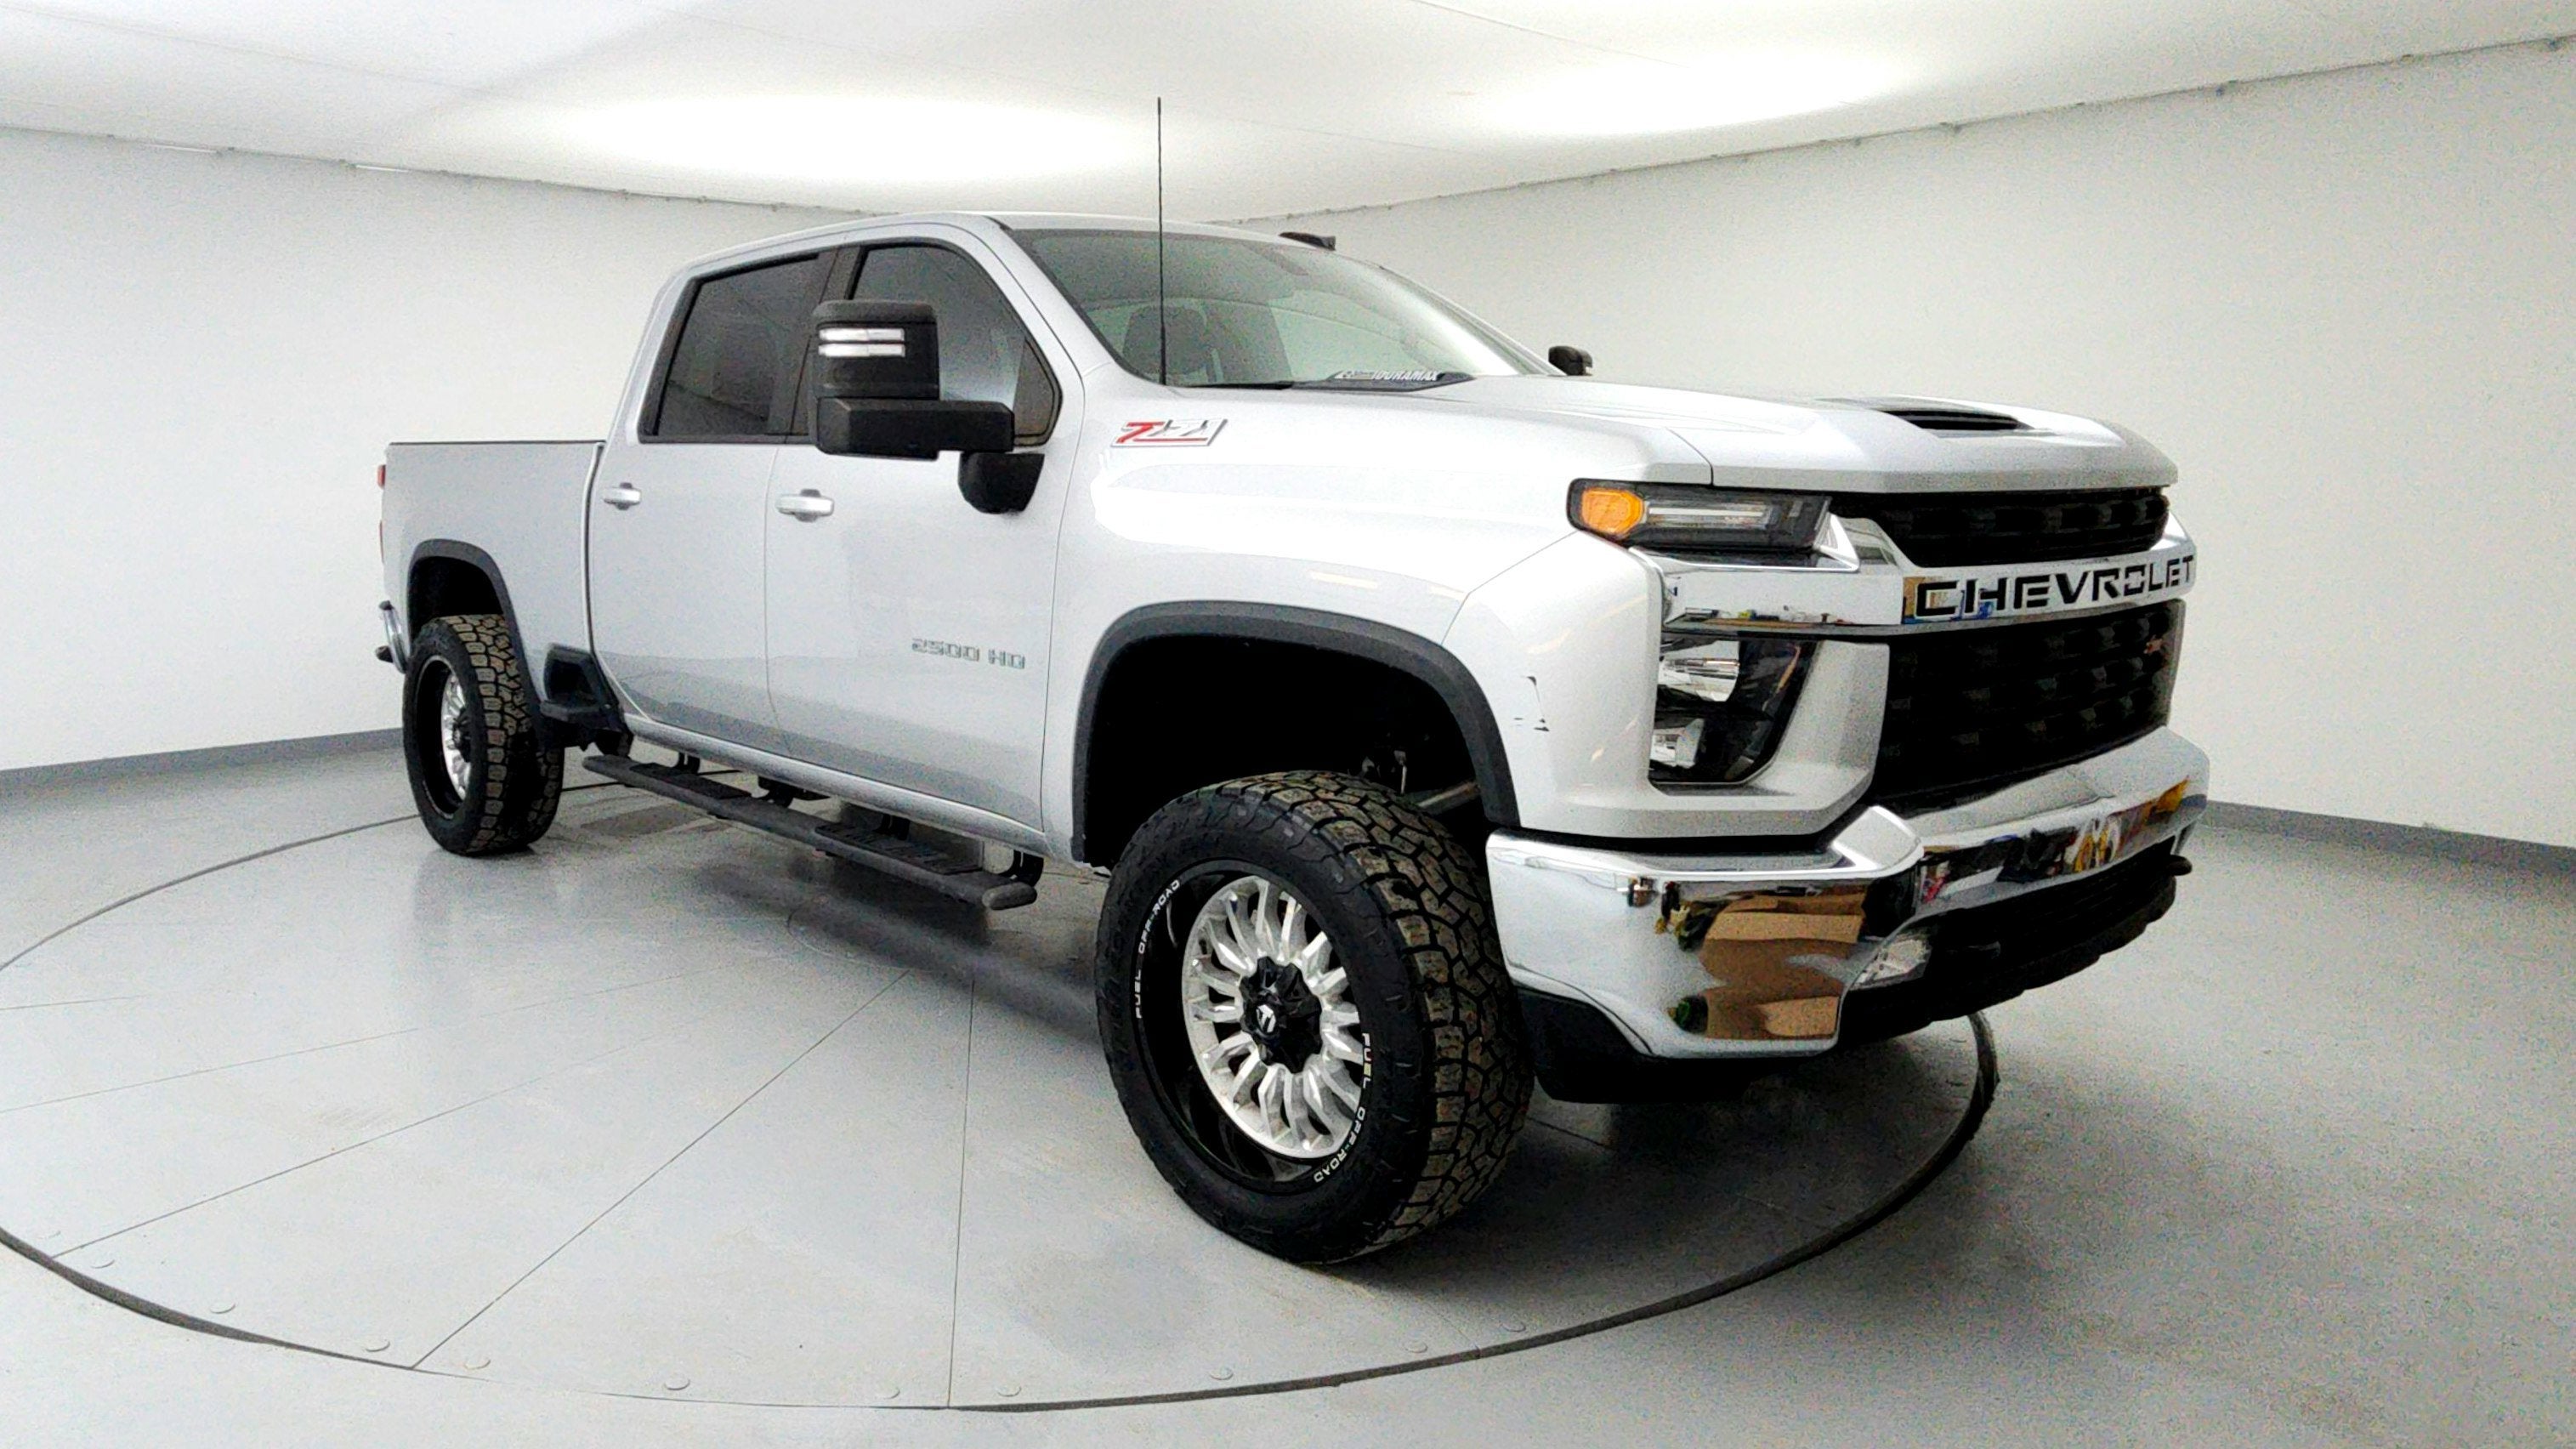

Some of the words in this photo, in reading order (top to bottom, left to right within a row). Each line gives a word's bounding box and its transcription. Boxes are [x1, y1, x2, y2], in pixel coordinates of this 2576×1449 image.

[1371, 370, 1443, 381] DURAMAX
[1915, 554, 2194, 617] CHEVROLET
[911, 638, 979, 662] 2500
[988, 648, 1025, 669] HD
[1134, 969, 1143, 1019] FUEL
[1362, 1032, 1371, 1088] FUEL
